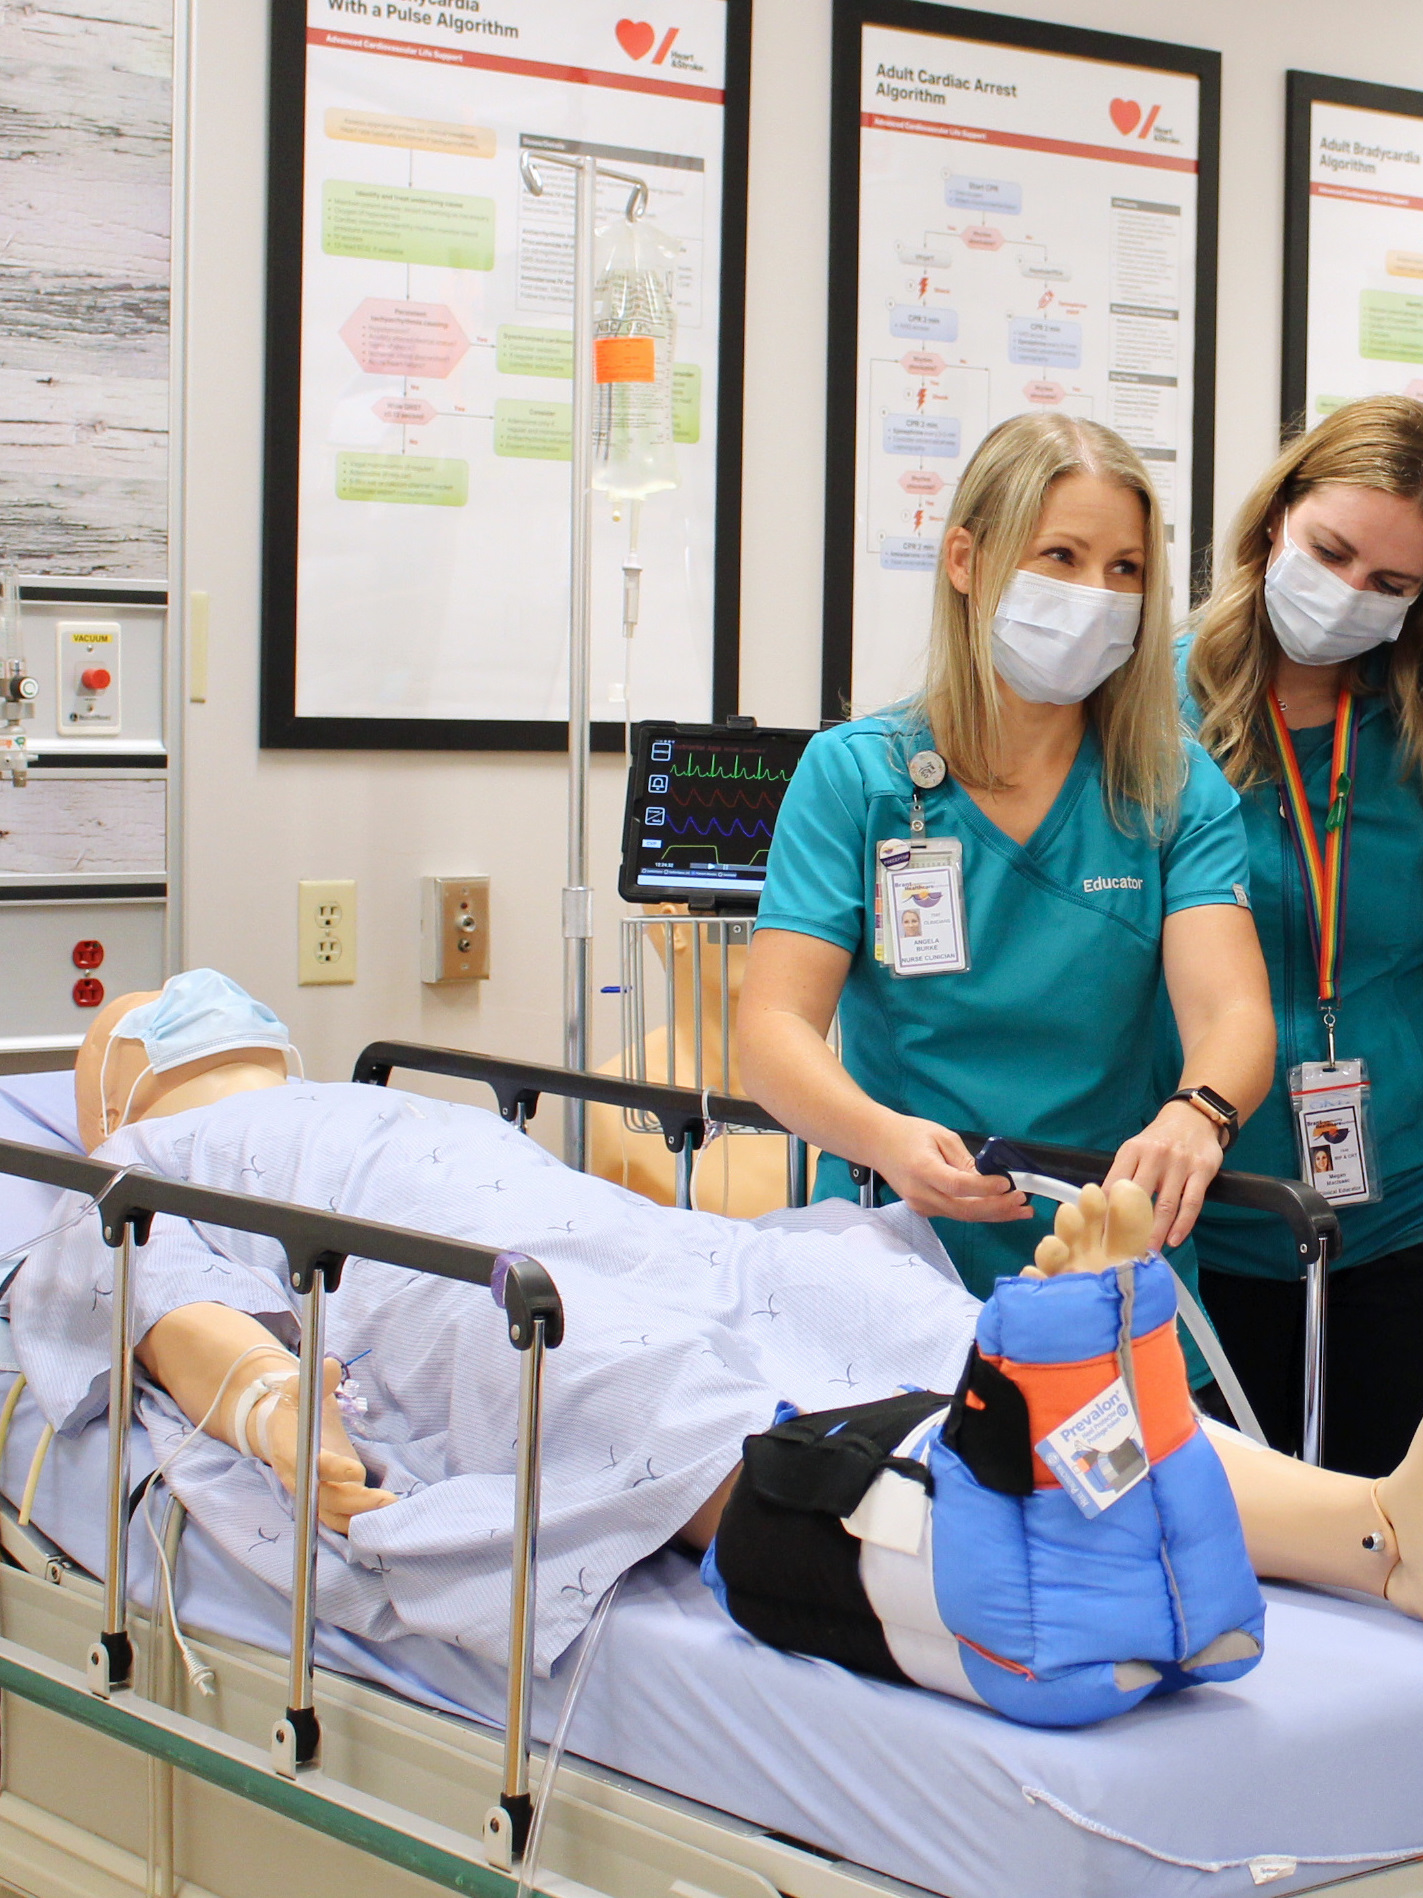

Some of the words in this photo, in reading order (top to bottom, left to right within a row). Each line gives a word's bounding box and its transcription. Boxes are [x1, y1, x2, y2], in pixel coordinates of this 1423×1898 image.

[328, 0, 367, 15] With
[372, 5, 382, 17] a
[387, 4, 432, 25] Pulse
[437, 12, 519, 39] Algorithm
[876, 63, 914, 81] Adult
[918, 70, 970, 91] Cardiac
[974, 79, 1018, 98] Arrest
[876, 82, 946, 105] Algorithm
[1319, 136, 1351, 154] Adult
[1354, 141, 1421, 165] Bradycardia
[1319, 153, 1376, 175] Algorithm
[73, 634, 108, 643] VACUUM
[1082, 875, 1144, 893] Educator
[914, 937, 940, 945] ANGELA
[924, 953, 956, 961] CLINICIAN
[1060, 1393, 1120, 1443] Prevalon
